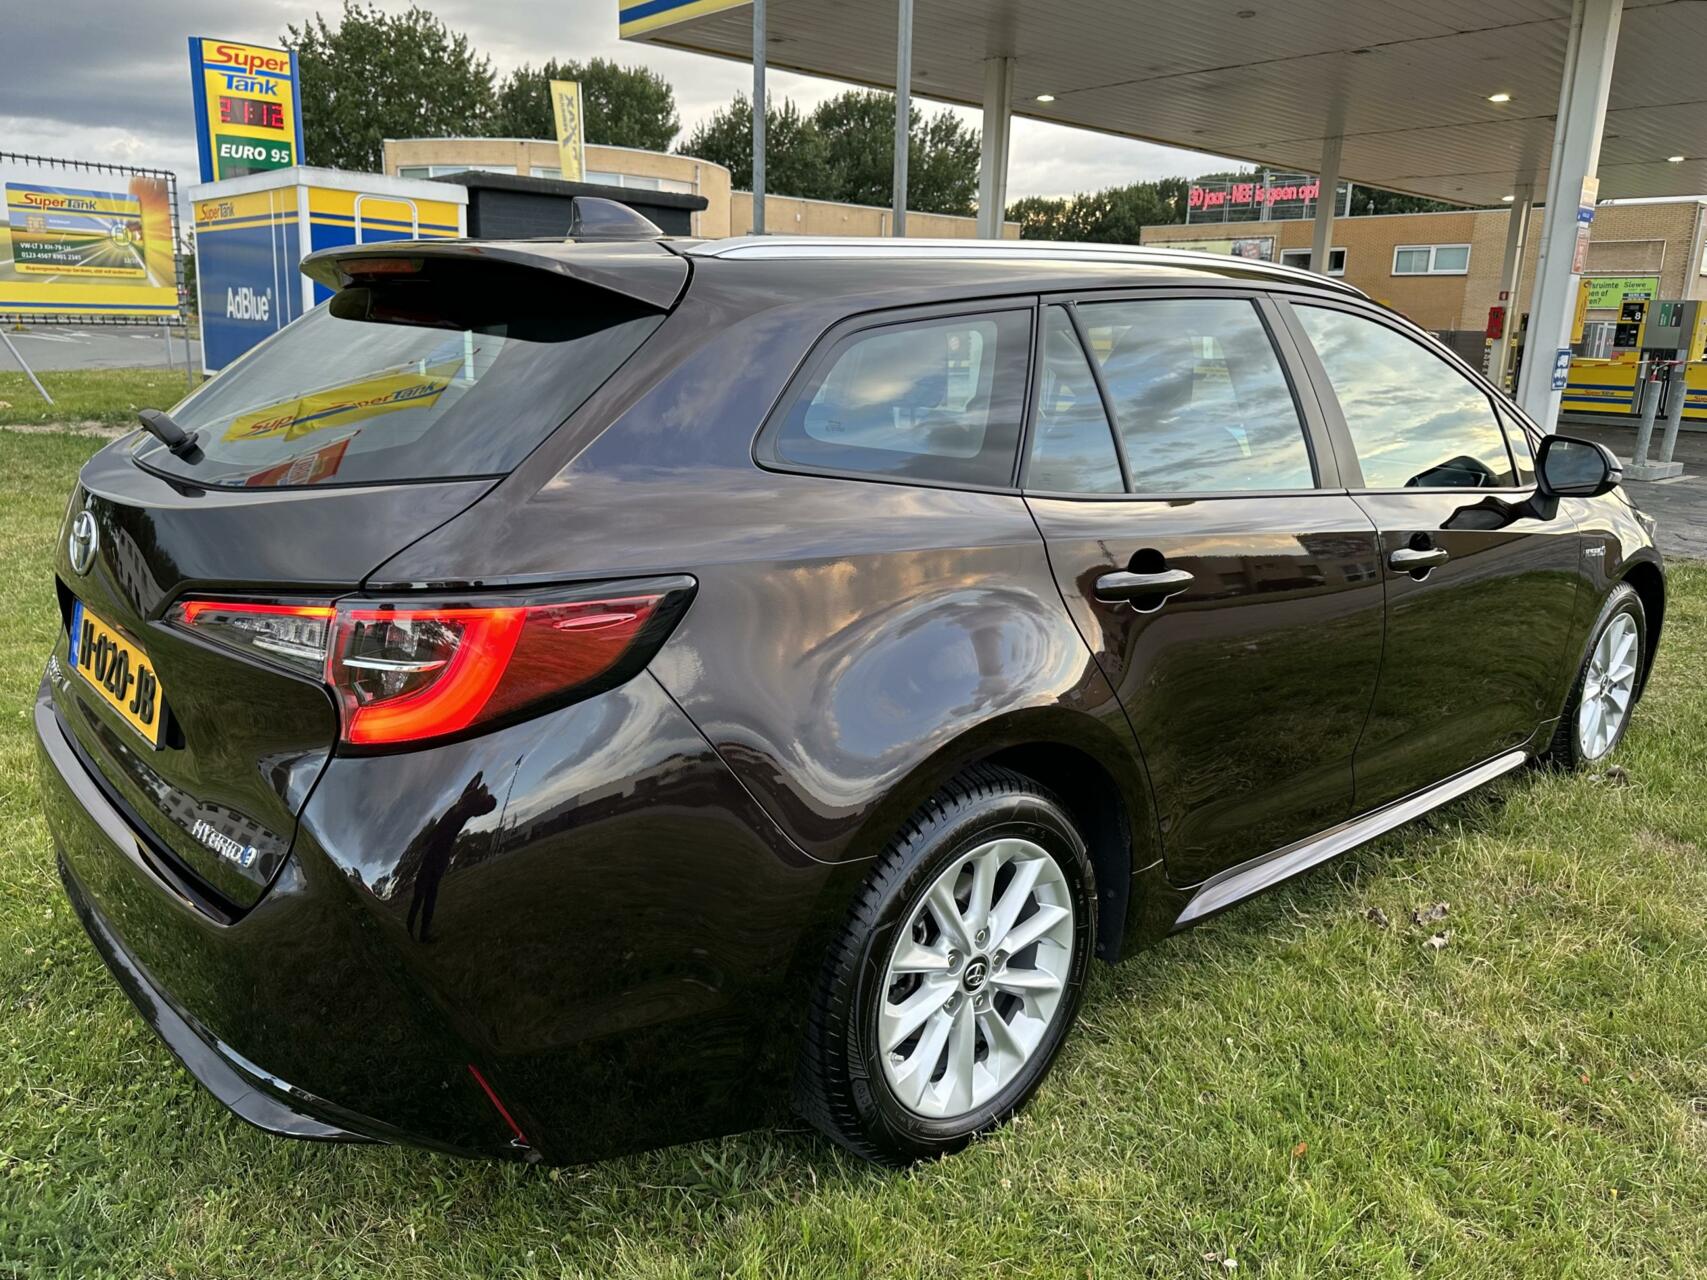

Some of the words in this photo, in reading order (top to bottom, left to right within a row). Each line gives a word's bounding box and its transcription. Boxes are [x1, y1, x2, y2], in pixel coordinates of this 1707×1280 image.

[203, 45, 288, 75] Super
[218, 73, 278, 96] Tank
[219, 98, 284, 128] 21:12
[220, 143, 267, 161] EURO
[271, 148, 290, 163] 95
[1266, 186, 1297, 208] geen
[1634, 311, 1642, 321] 8
[192, 819, 244, 861] HYBRID
